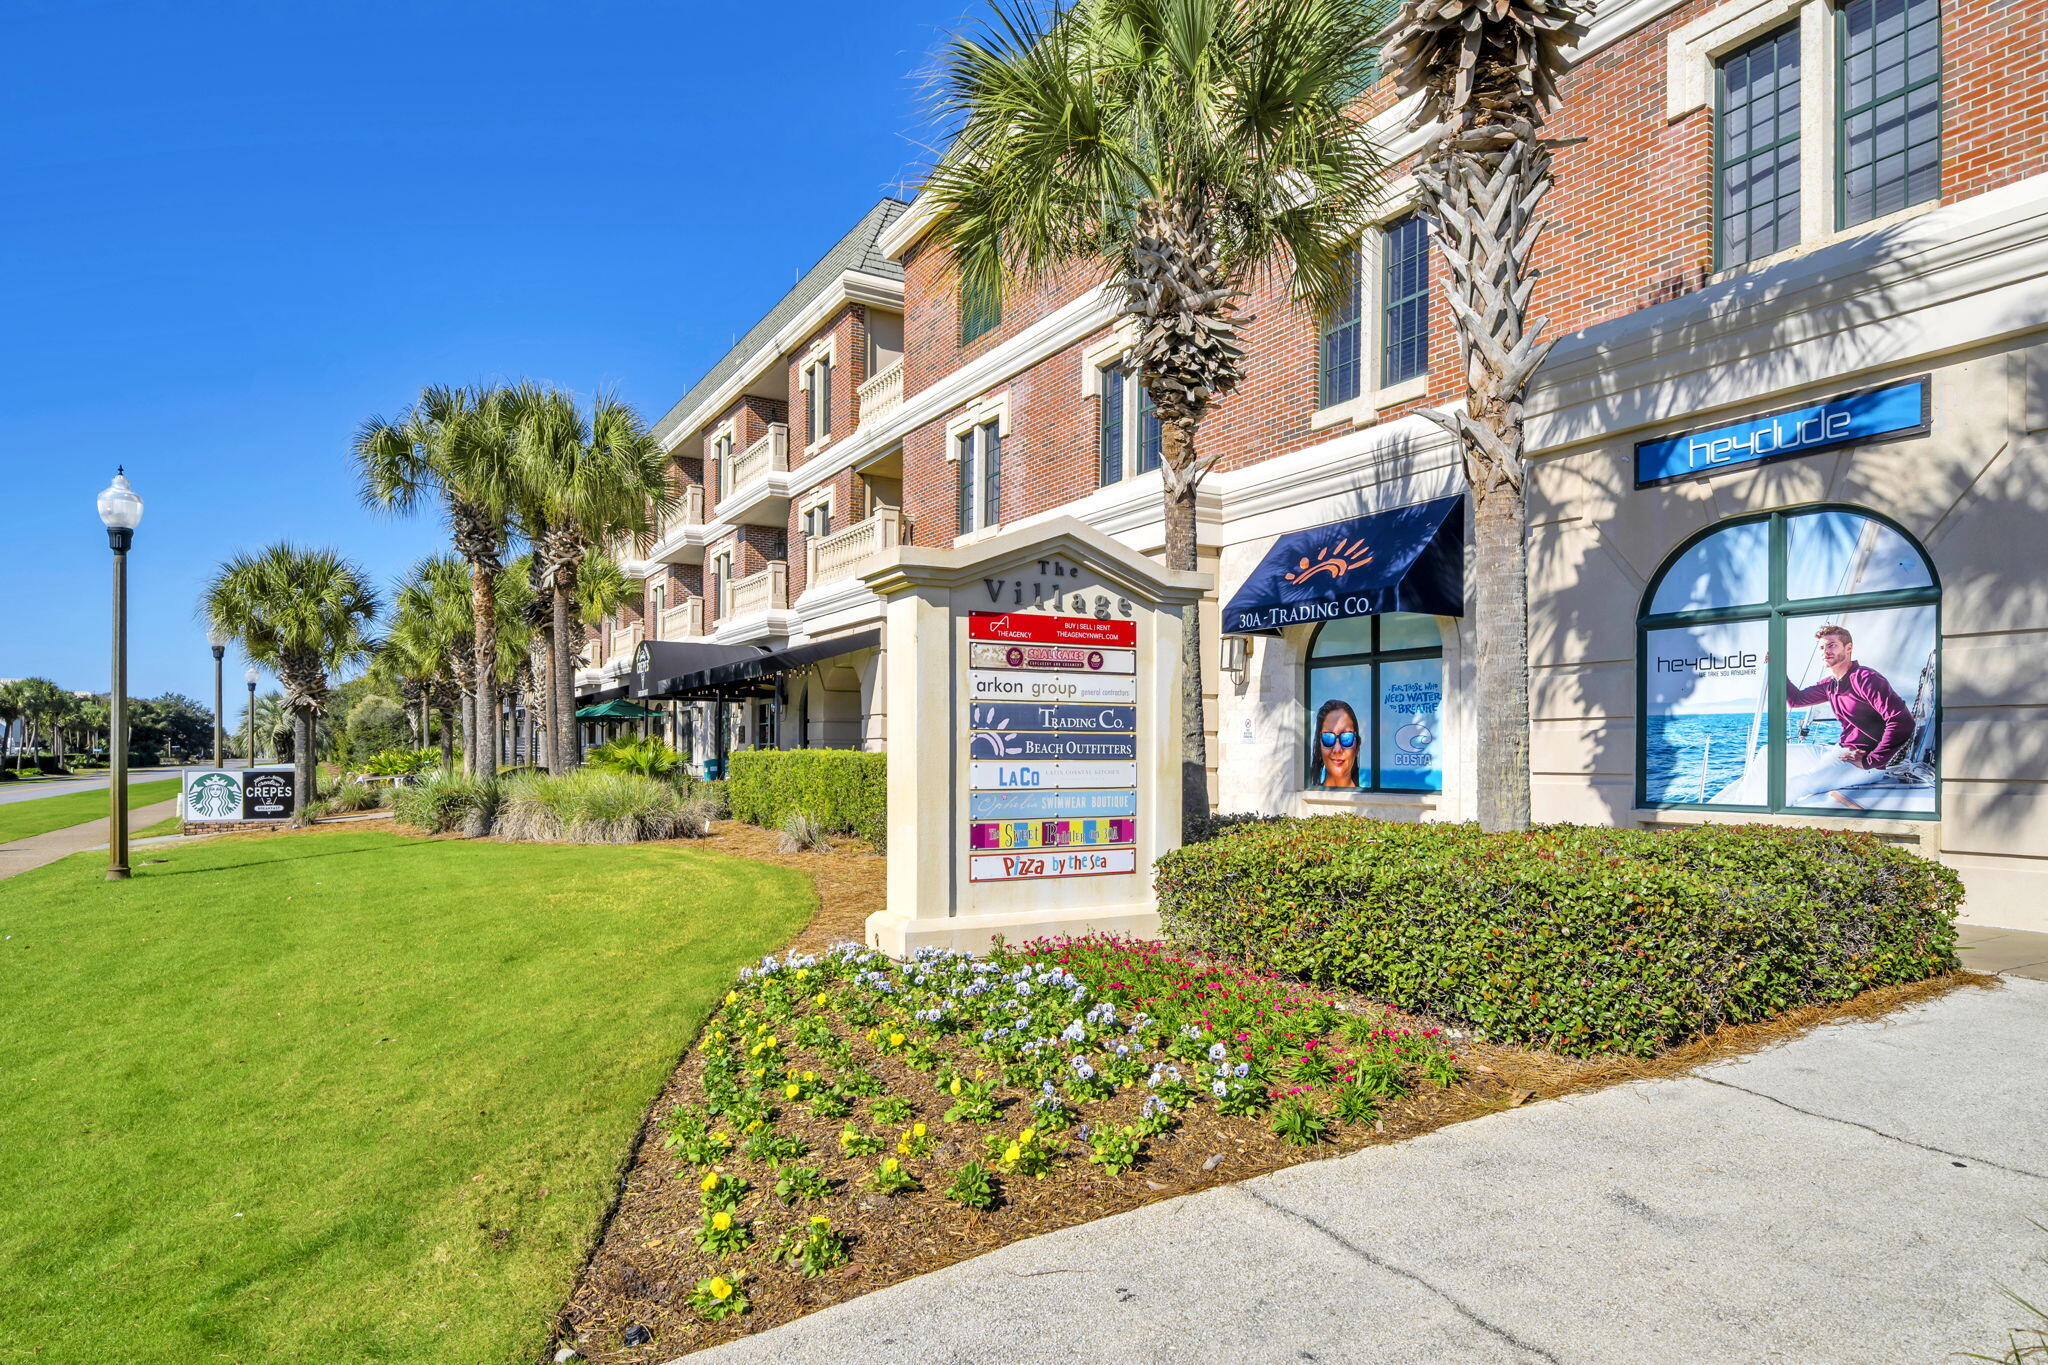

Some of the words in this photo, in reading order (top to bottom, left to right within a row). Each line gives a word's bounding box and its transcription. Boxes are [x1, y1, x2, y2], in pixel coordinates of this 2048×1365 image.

[1689, 409, 1851, 468] heydude
[1038, 560, 1079, 577] The
[984, 579, 1133, 620] Village
[1239, 613, 1261, 629] 30A
[1057, 630, 1119, 641] THEAGENCYNWFL.COM
[1657, 650, 1757, 673] heydude
[976, 676, 1023, 694] arkon
[1031, 680, 1077, 698] group
[1384, 693, 1405, 704] NEED
[1406, 692, 1443, 702] WATER
[1398, 702, 1438, 715] BREATHE
[1394, 753, 1432, 767] COSTA
[246, 787, 292, 797] CREPES
[1041, 797, 1087, 810] SWIMWEAR
[1091, 796, 1129, 808] BOUTIQUE
[1002, 855, 1045, 876] Pizza
[1052, 856, 1066, 874] by
[1068, 855, 1088, 870] the
